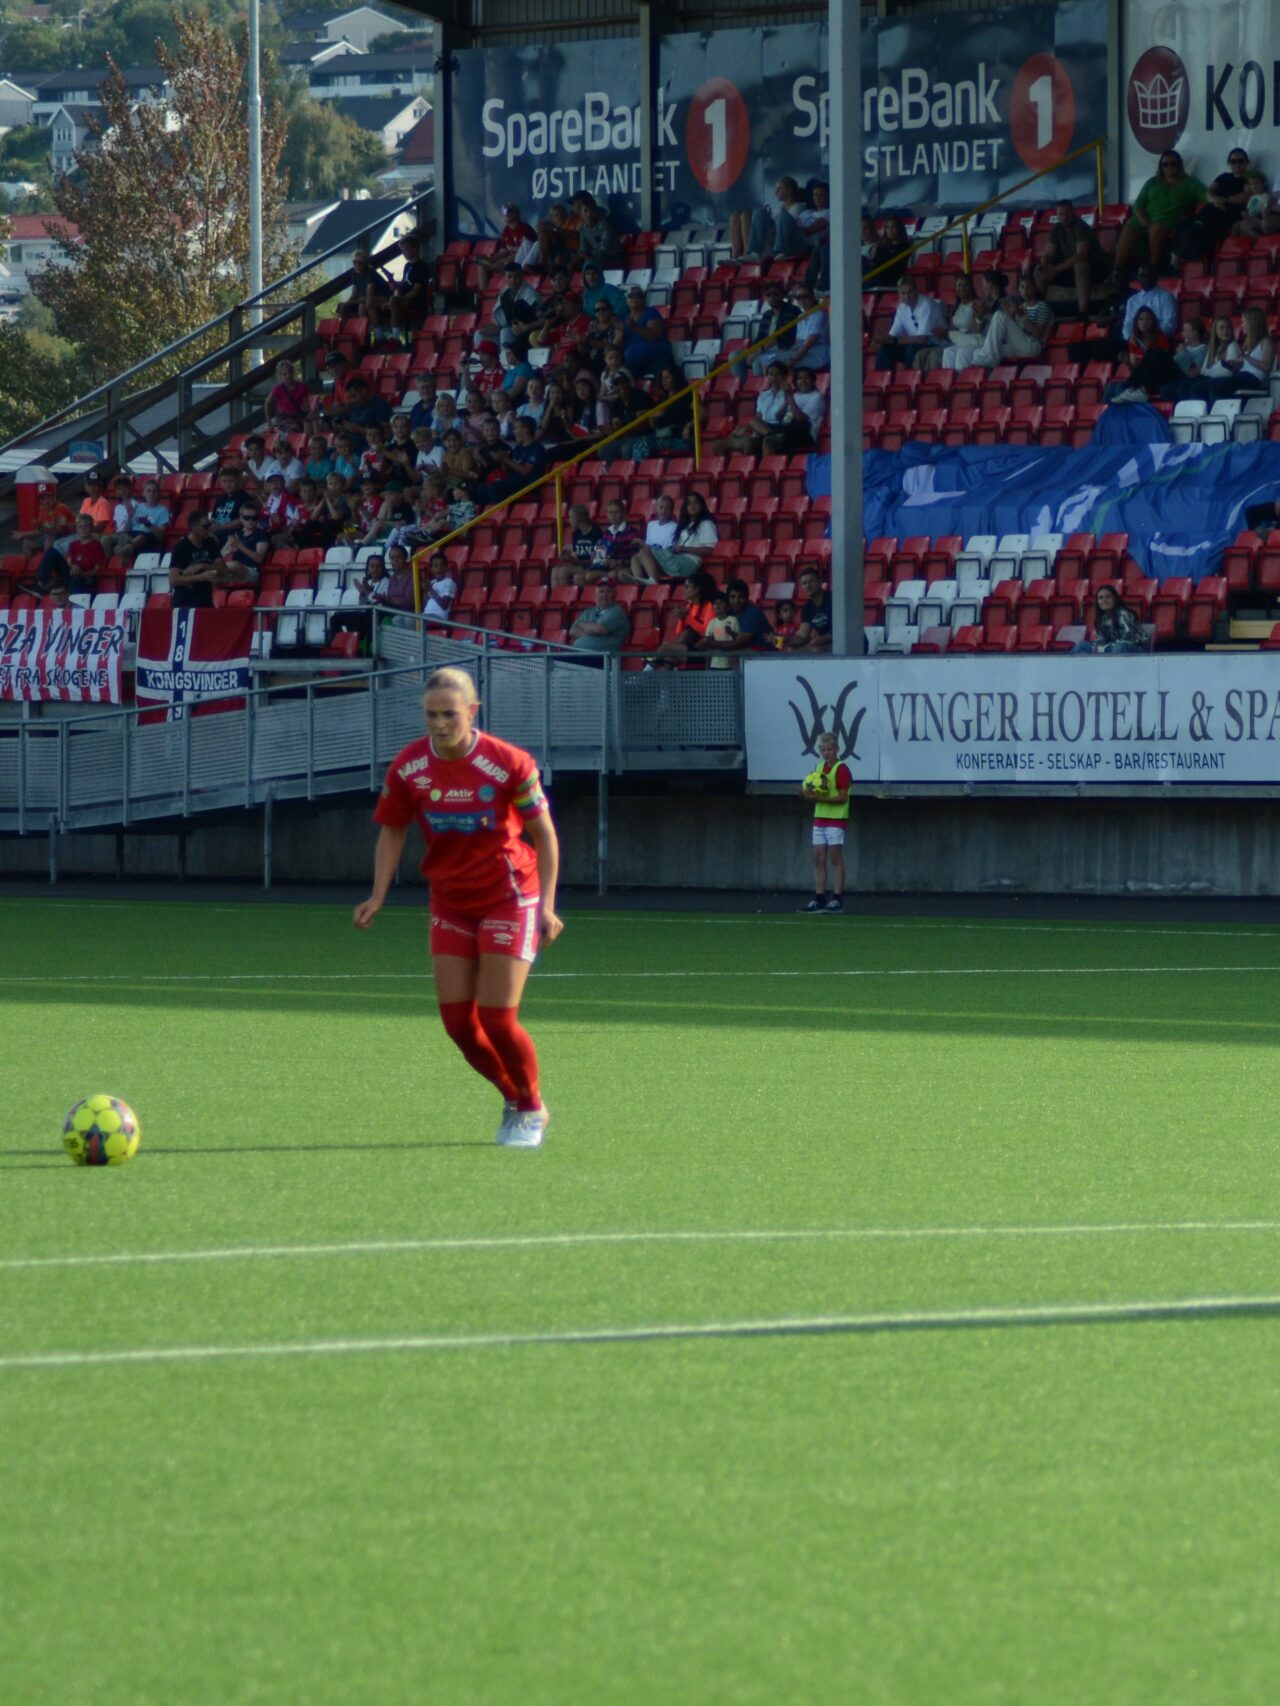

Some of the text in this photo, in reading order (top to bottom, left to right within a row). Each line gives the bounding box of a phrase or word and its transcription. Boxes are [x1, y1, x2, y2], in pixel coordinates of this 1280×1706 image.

[793, 62, 1053, 150] SreBank 1
[705, 99, 727, 170] 1
[864, 138, 1004, 178] STLANDET
[44, 621, 124, 655] VINGER
[15, 667, 41, 688] FRA
[46, 665, 108, 688] SKOGENE
[145, 670, 239, 691] KONGSVINGER
[884, 691, 1023, 743] VINGER
[1029, 690, 1179, 742] HOTELL
[1189, 690, 1215, 742] &
[1047, 752, 1102, 770] SELSKAP
[1114, 751, 1226, 771] BAR/RESTAURANT
